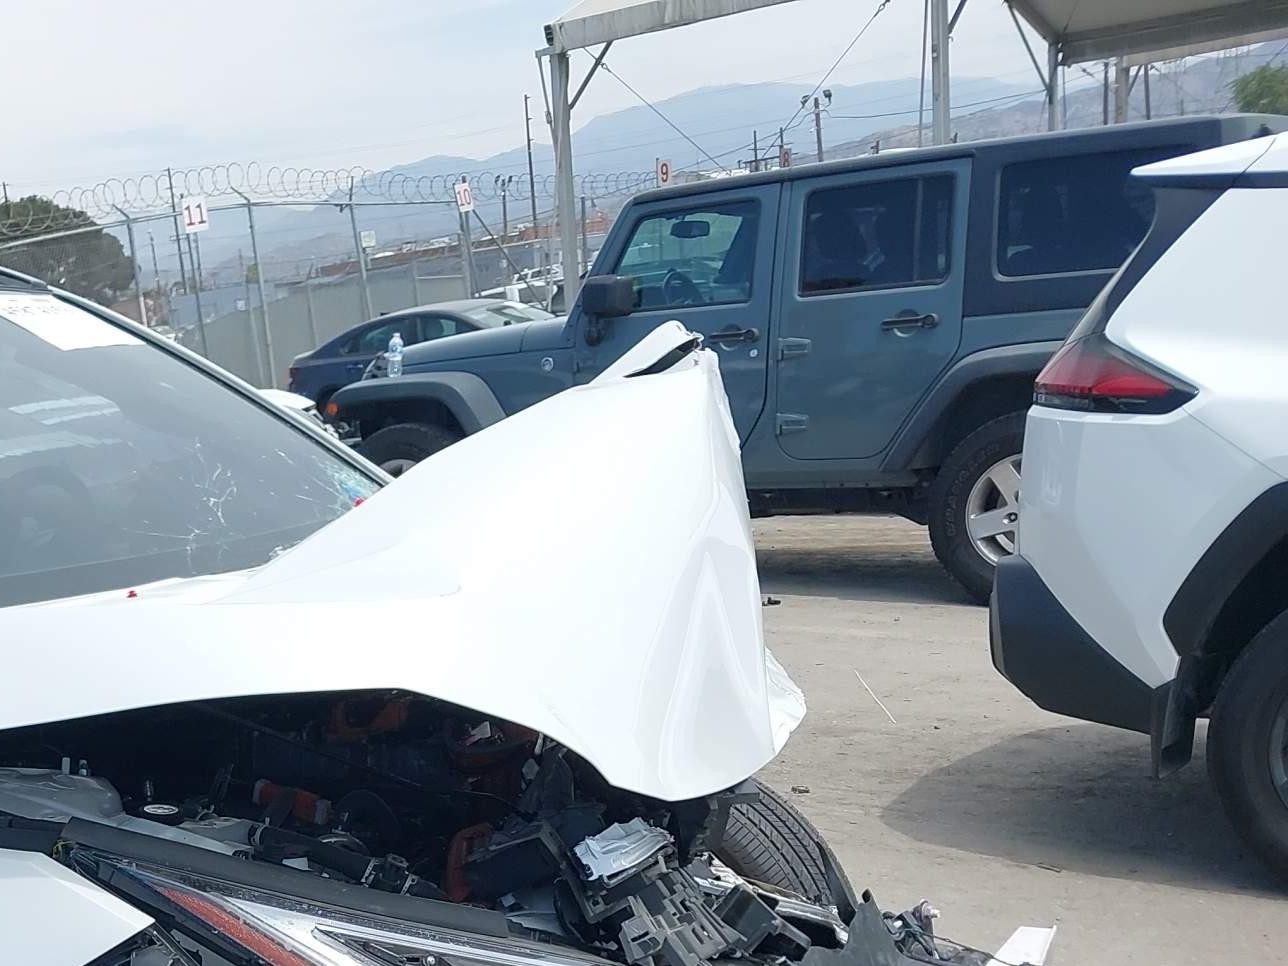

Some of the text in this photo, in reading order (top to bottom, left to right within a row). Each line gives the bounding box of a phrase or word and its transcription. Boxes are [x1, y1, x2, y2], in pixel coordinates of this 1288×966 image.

[660, 163, 669, 182] 9
[457, 188, 471, 206] 10
[184, 203, 207, 226] 11
